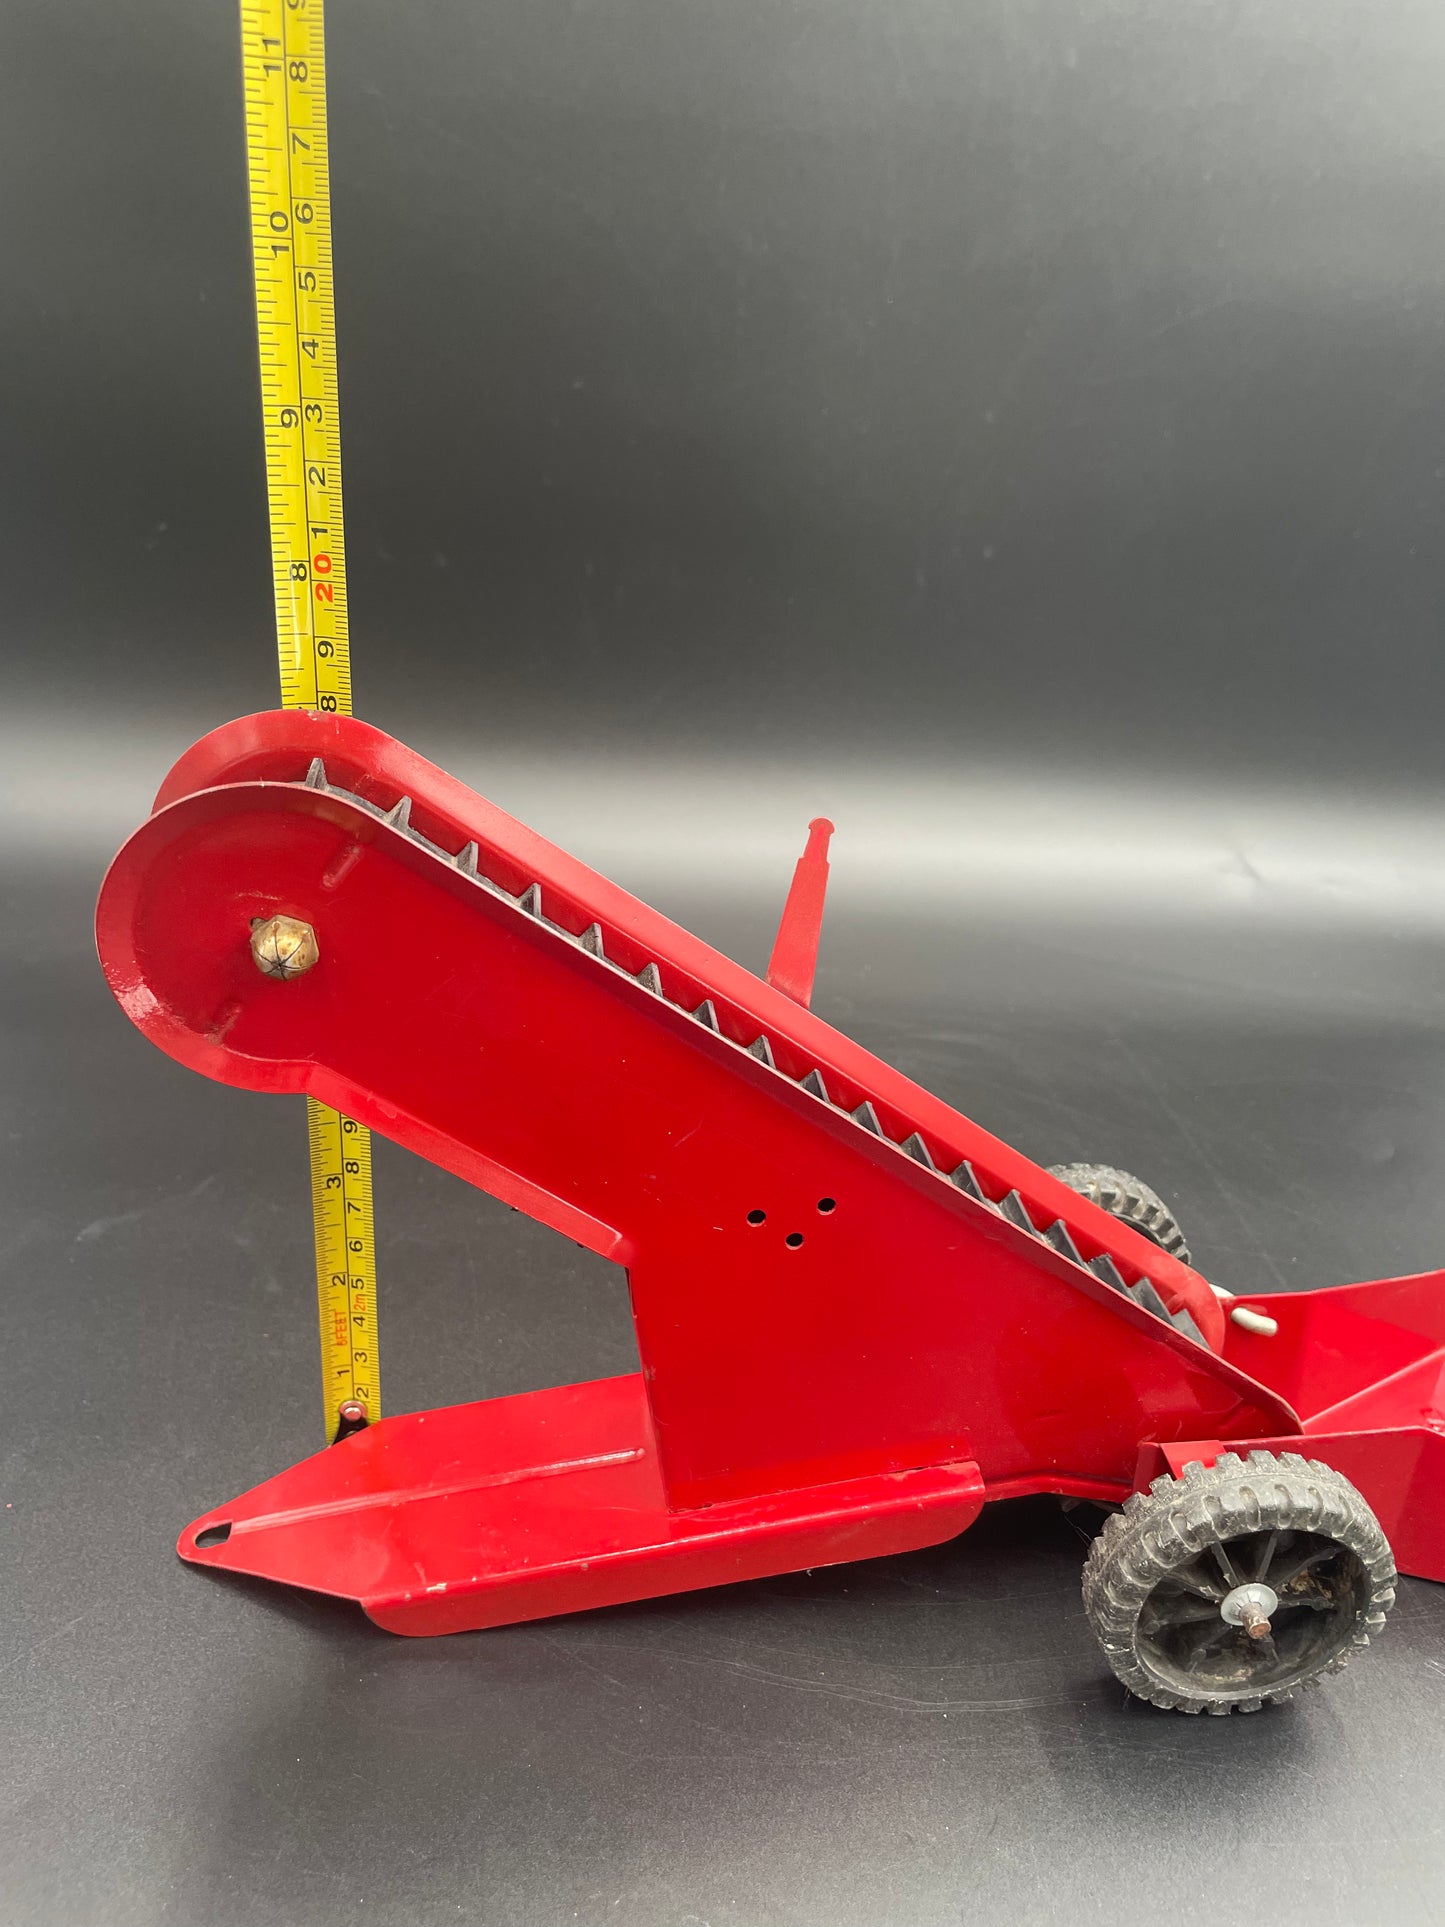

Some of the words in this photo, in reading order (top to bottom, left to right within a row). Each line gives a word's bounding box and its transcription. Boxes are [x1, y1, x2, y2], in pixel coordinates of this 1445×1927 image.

[262, 38, 281, 78] 11
[289, 61, 308, 82] 8
[292, 133, 310, 154] 7
[295, 203, 313, 224] 6
[270, 211, 289, 258] 10
[299, 272, 316, 292] 5
[302, 339, 319, 359] 4
[281, 408, 299, 428] 9
[305, 404, 322, 423] 3
[308, 466, 326, 486] 2
[311, 527, 328, 539] 1
[290, 563, 307, 581] 8
[314, 554, 333, 603] 20
[318, 640, 334, 658] 9
[321, 695, 337, 713] 8
[343, 1120, 358, 1133] 9
[345, 1161, 359, 1174] 8
[327, 1176, 341, 1189] 3
[347, 1201, 361, 1214] 7
[349, 1240, 363, 1252] 6
[332, 1274, 346, 1286] 2
[351, 1278, 364, 1290] 5
[353, 1294, 366, 1311] 2m
[353, 1315, 366, 1327] 4
[354, 1351, 368, 1363] 3
[336, 1369, 350, 1378] 1
[356, 1387, 369, 1398] 2
